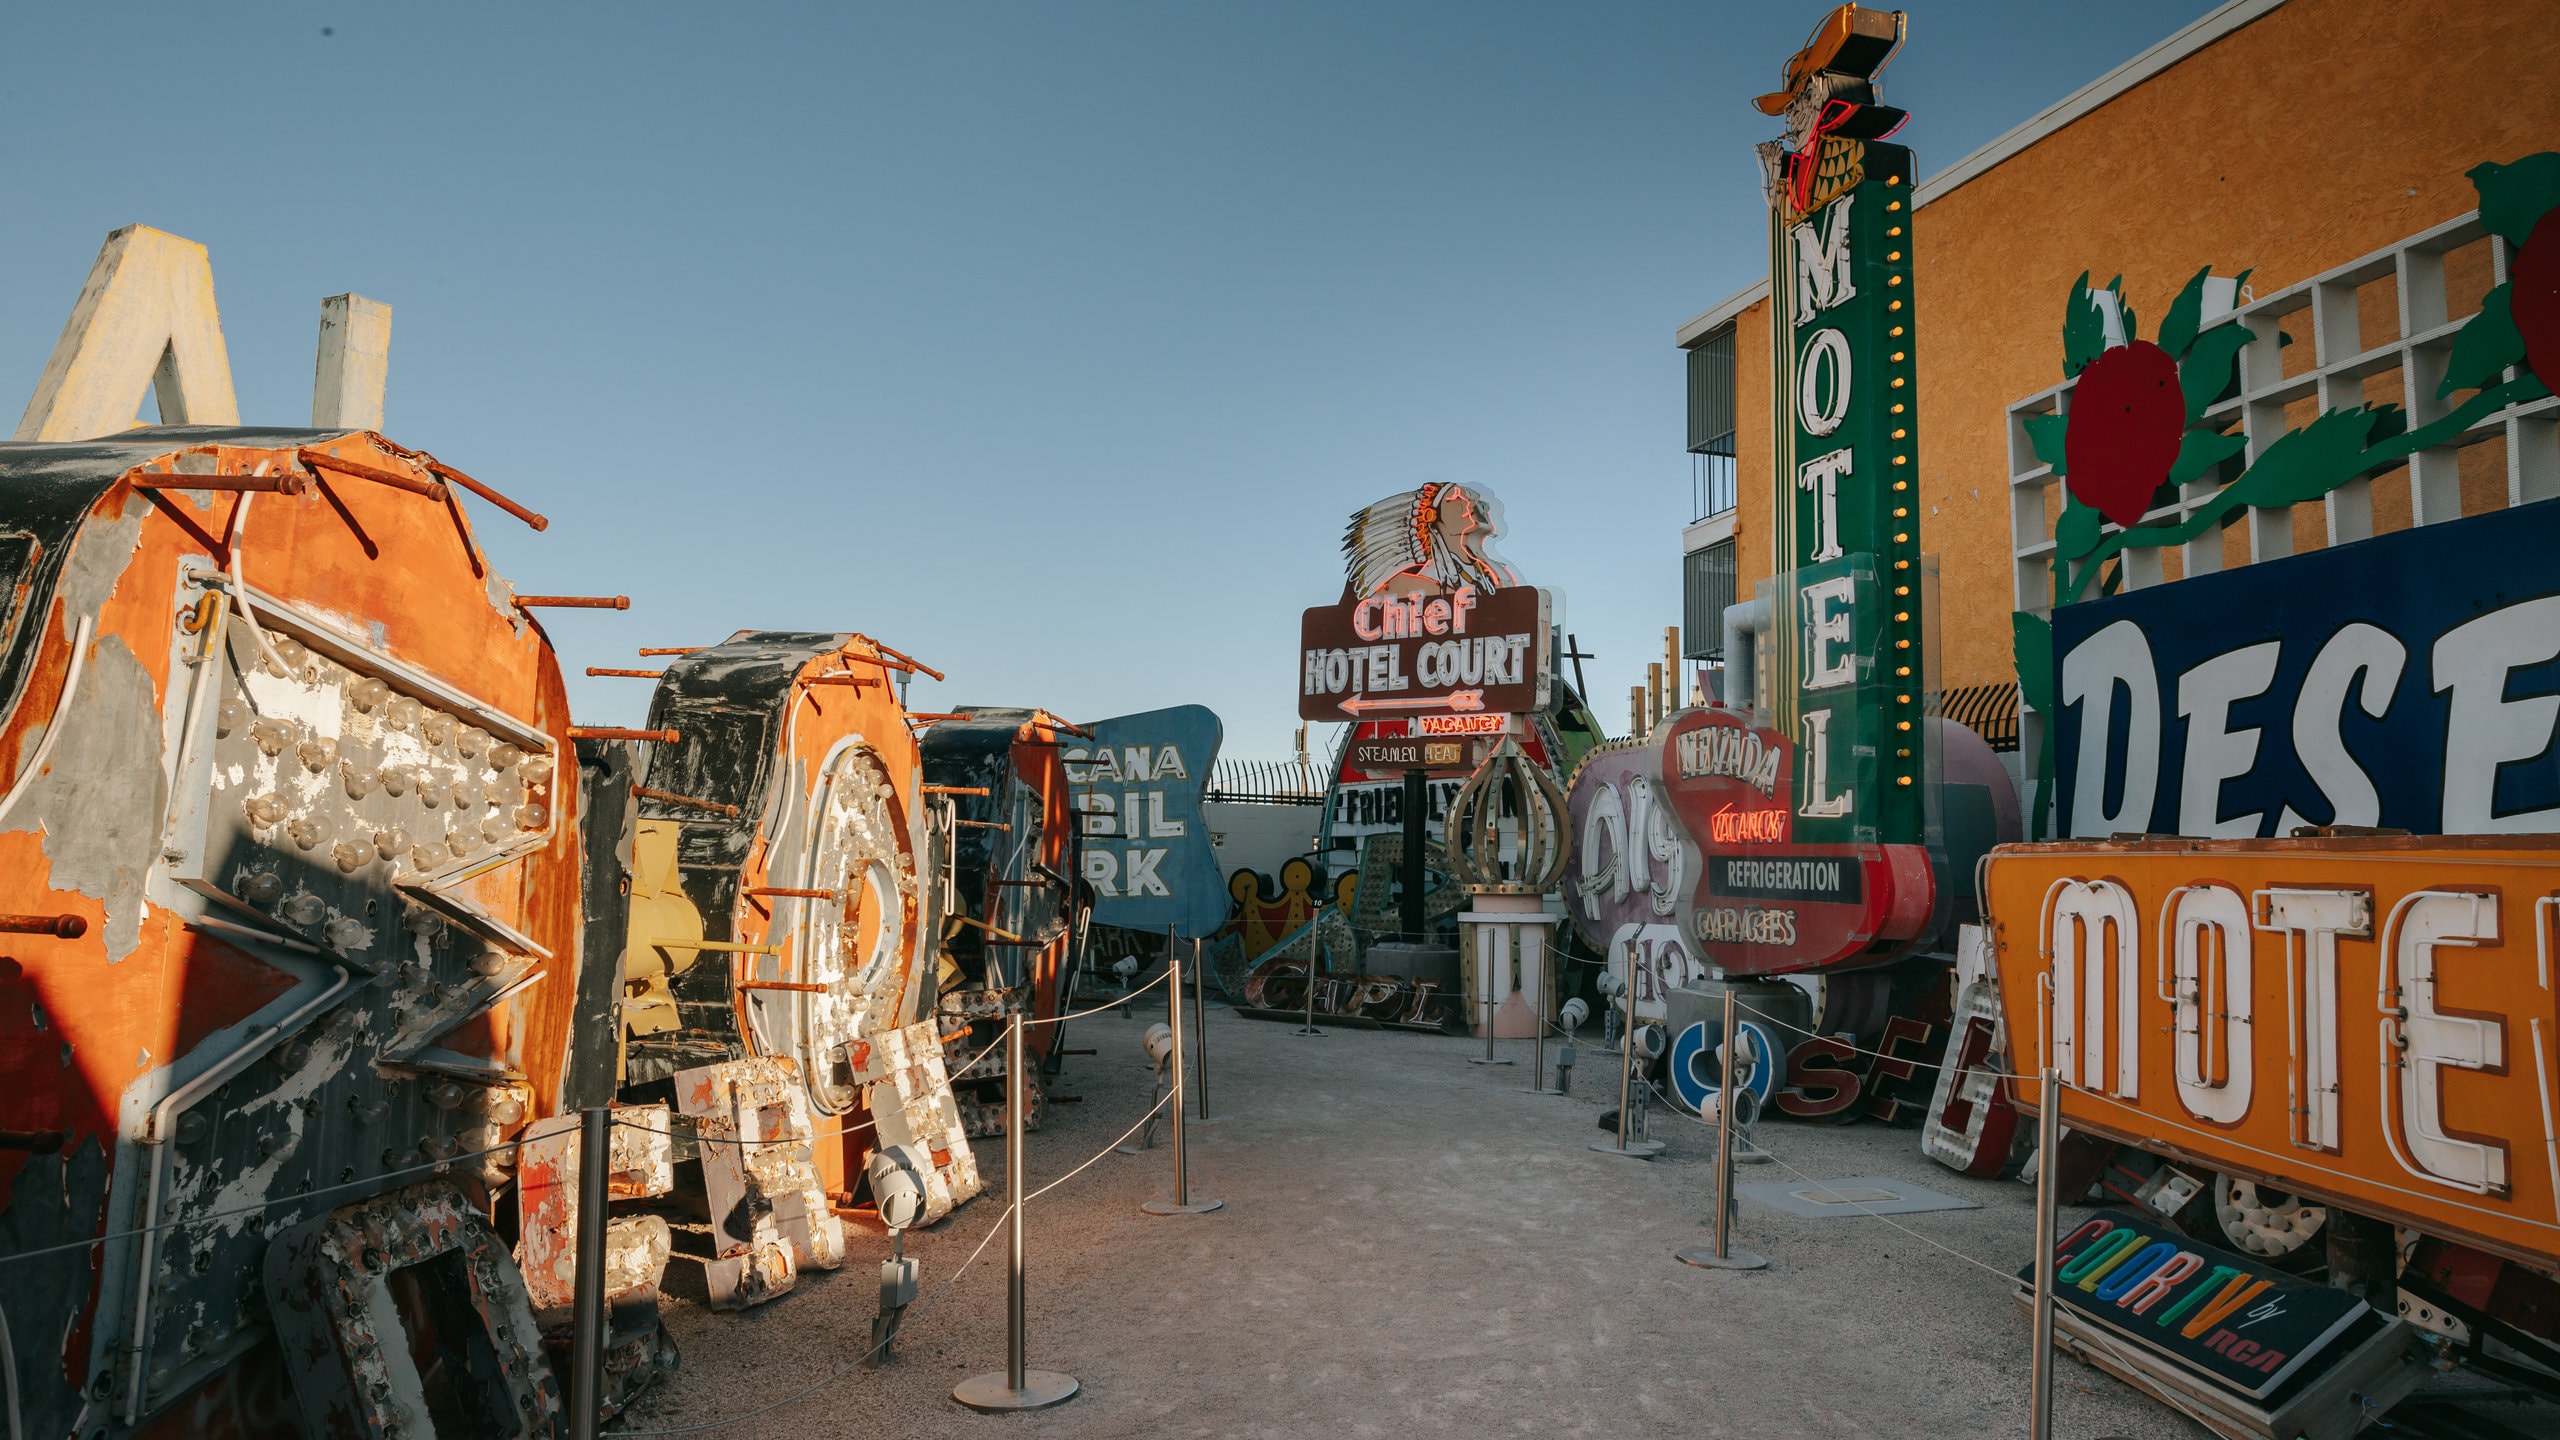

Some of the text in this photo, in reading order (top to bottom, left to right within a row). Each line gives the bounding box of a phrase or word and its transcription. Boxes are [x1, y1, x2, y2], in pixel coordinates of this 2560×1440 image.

[1790, 193, 1859, 822] MOTEL
[1353, 586, 1477, 641] Chief
[1304, 633, 1531, 696] HOTEL COURT
[1421, 714, 1505, 734] VACANCY
[1358, 746, 1419, 762] STEAMED
[1676, 725, 1782, 800] NEVADA
[1711, 802, 1788, 843] VACANCY
[1727, 861, 1840, 892] REFRIGERATION
[1693, 905, 1799, 947] GARAGES
[2055, 1219, 2288, 1341] COLOR TV by
[2202, 1328, 2288, 1374] RCA
